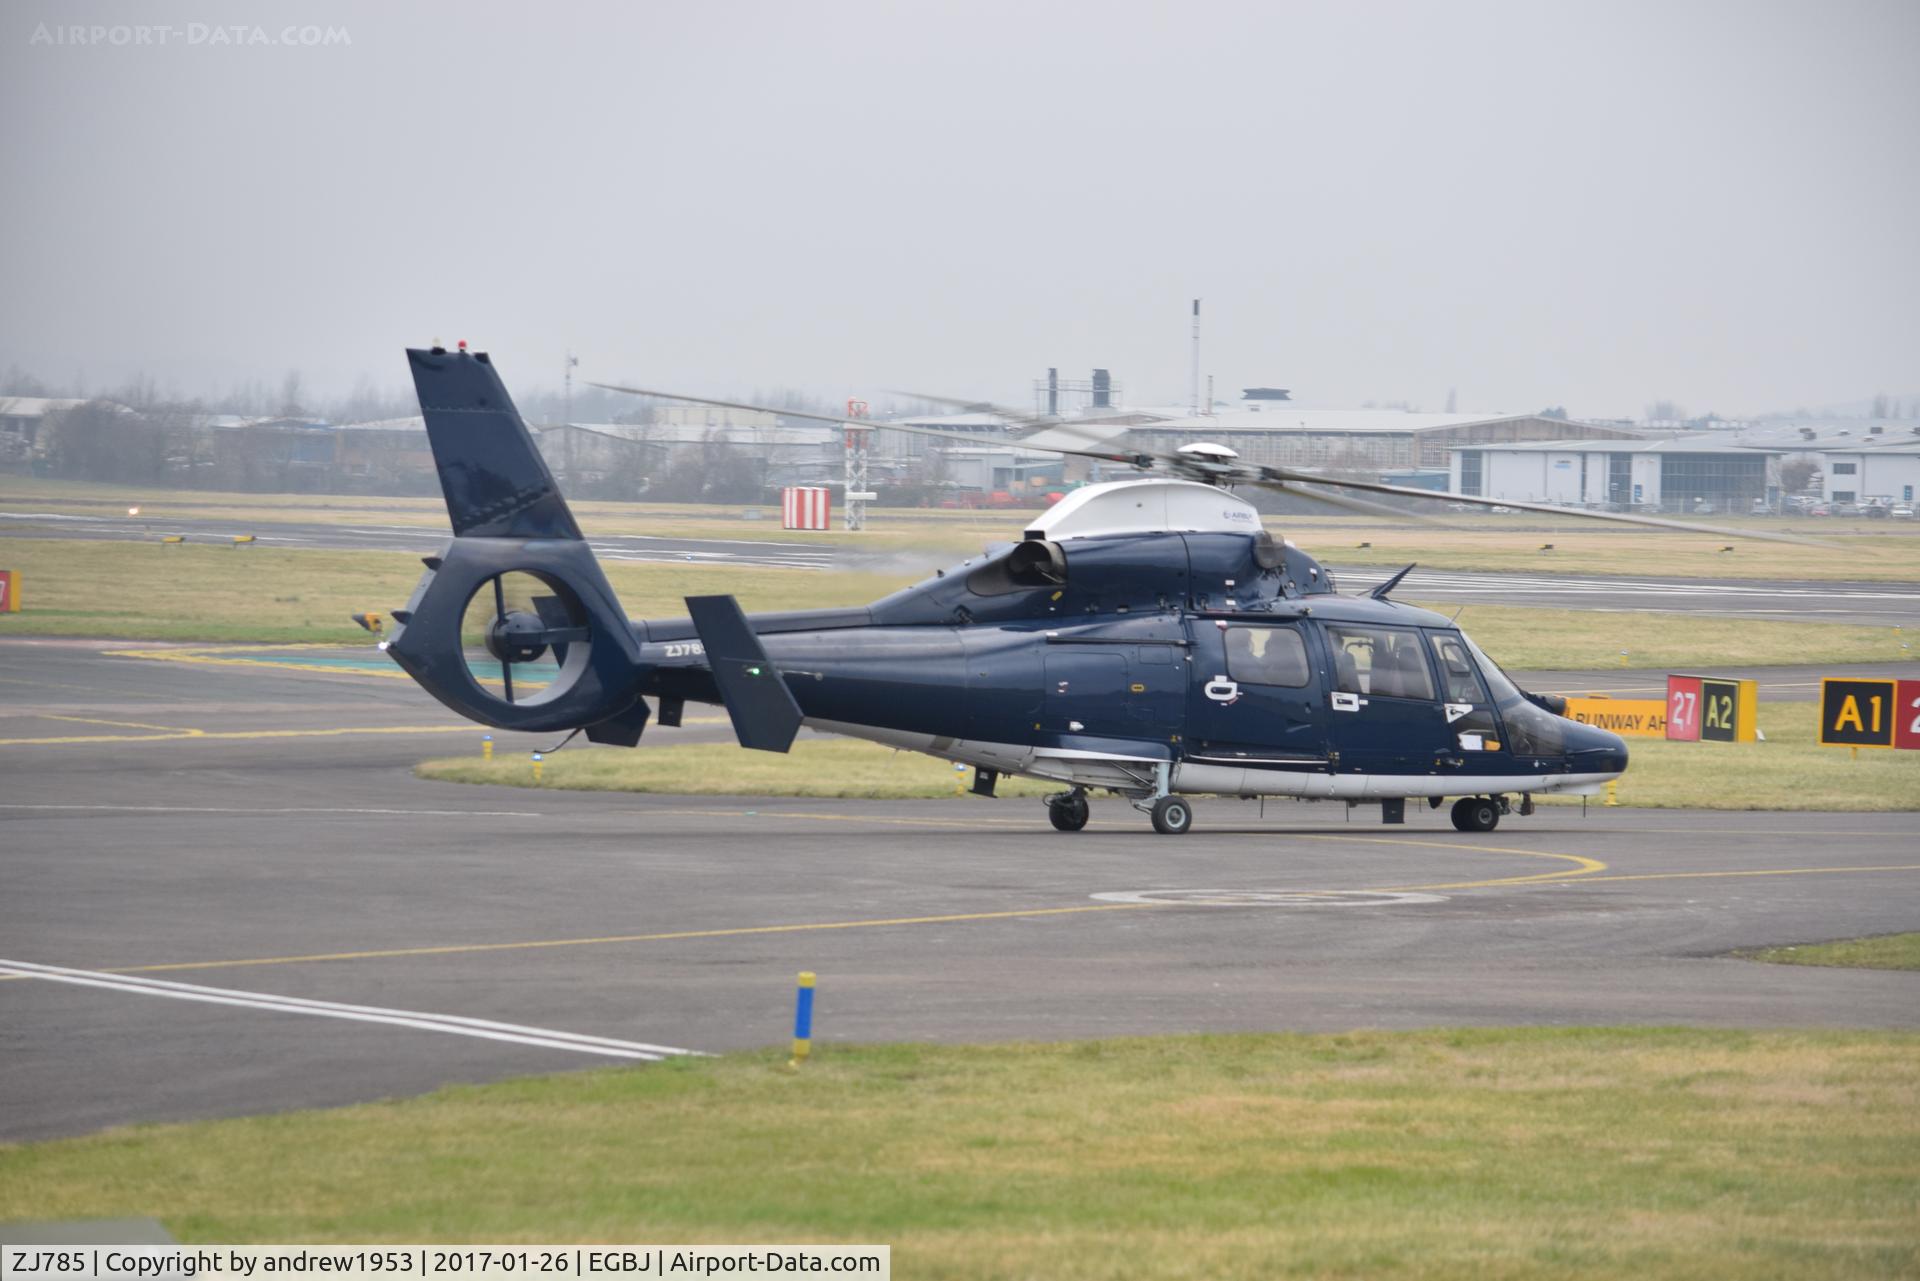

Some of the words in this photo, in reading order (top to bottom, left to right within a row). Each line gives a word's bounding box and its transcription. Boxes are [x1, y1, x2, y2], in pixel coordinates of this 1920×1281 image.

[1672, 691, 1697, 730] 27
[1706, 694, 1733, 729] A2
[1834, 694, 1882, 733] A1
